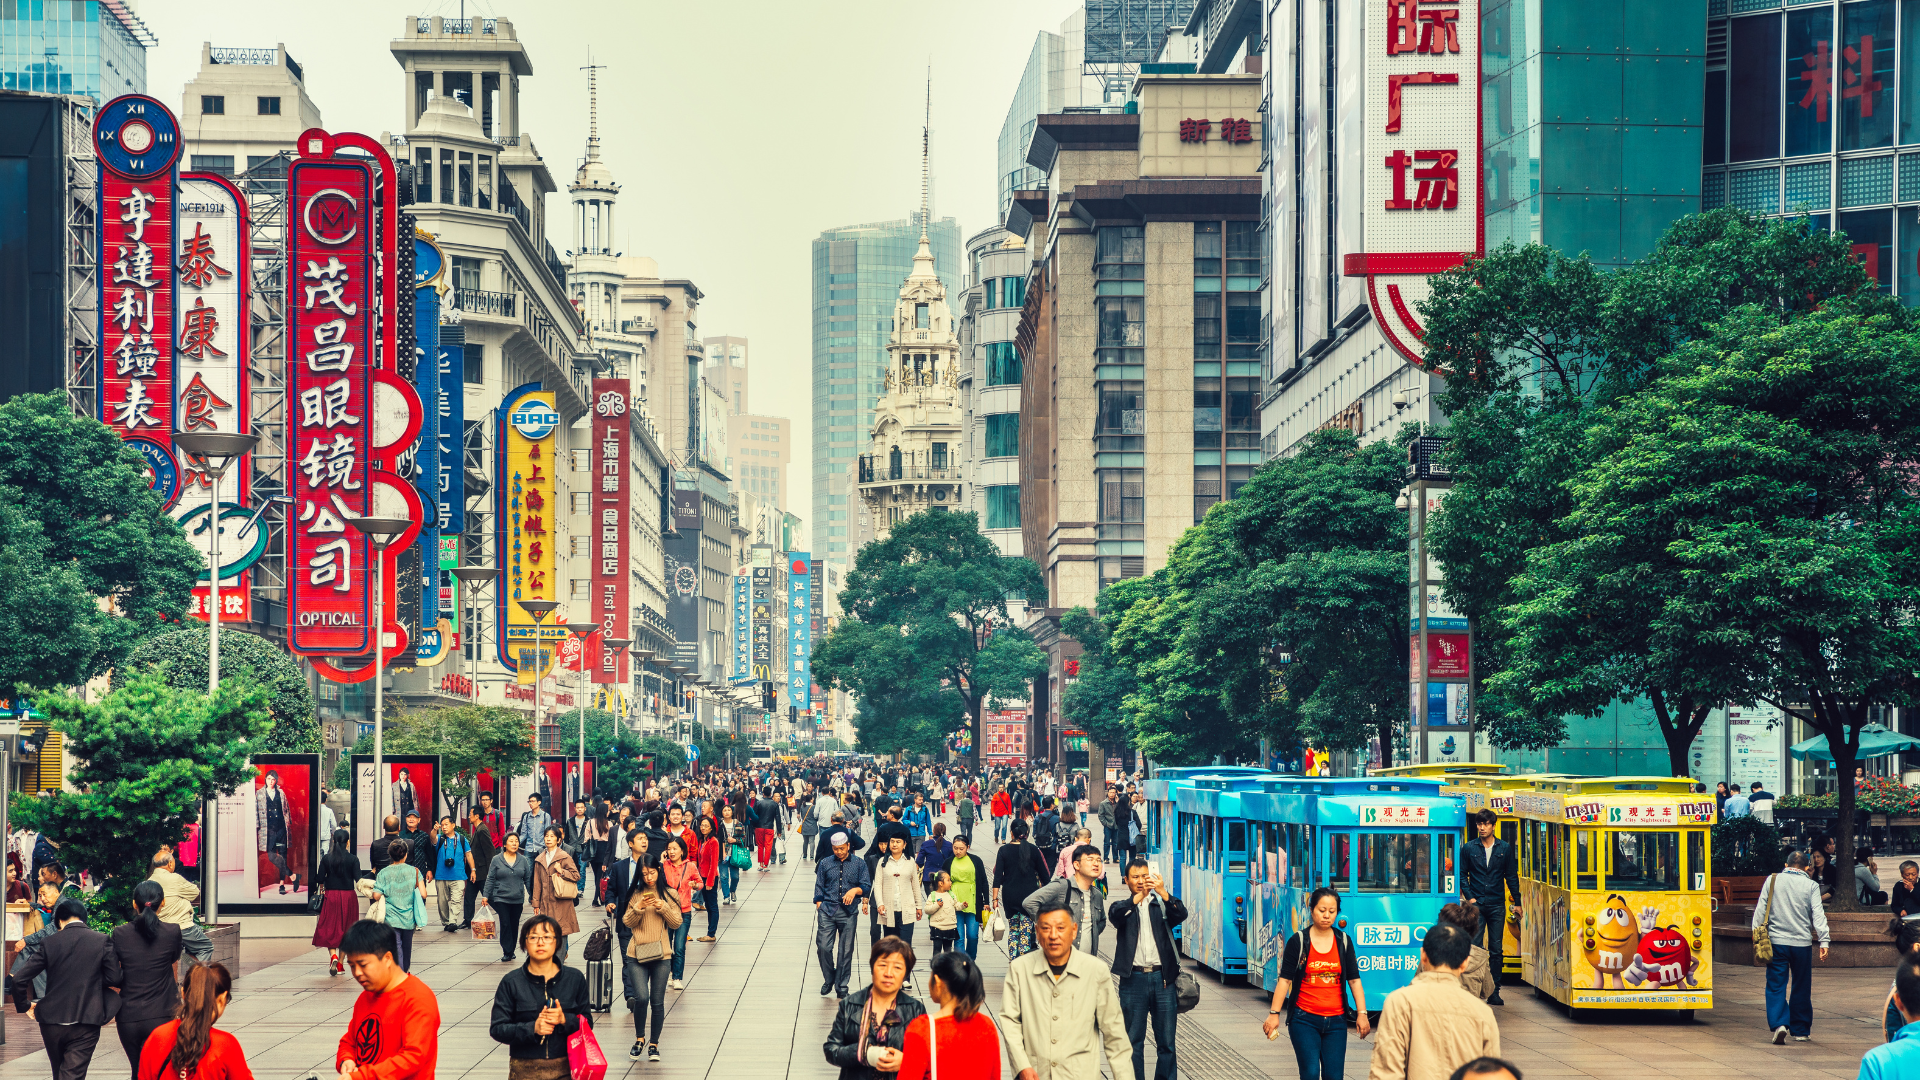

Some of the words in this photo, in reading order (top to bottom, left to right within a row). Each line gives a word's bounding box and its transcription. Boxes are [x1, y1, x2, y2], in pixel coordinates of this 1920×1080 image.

[127, 104, 145, 114] XII
[100, 130, 115, 140] IX
[1179, 117, 1253, 143] 新雅
[129, 159, 144, 169] VI
[300, 256, 361, 592] 茂昌眼镜公司
[512, 413, 559, 425] BAC
[602, 425, 619, 576] 上海市第一食品商店
[604, 585, 616, 610] First
[300, 612, 360, 626] OPTICAL
[509, 629, 567, 637] 创建于942年
[1383, 807, 1425, 817] 观光车
[1629, 807, 1671, 817] 观光车
[1447, 878, 1453, 891] 5
[1697, 875, 1703, 889] 7
[1363, 927, 1402, 943] 脉动
